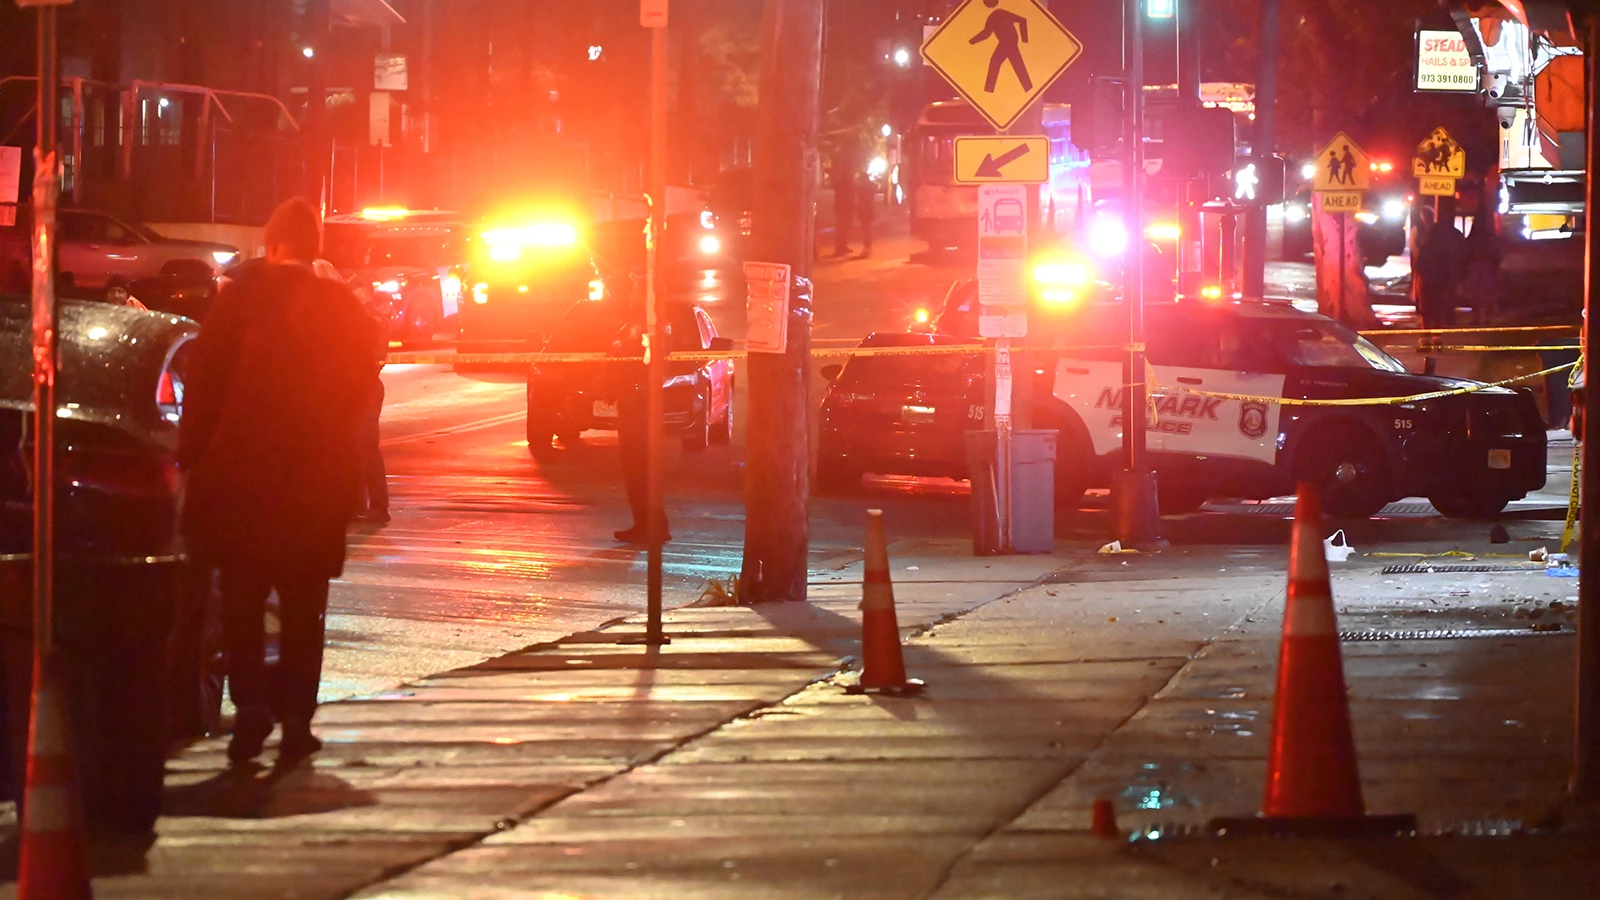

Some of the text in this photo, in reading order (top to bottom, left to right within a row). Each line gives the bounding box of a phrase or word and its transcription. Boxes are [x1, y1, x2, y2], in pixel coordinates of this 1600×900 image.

[1424, 38, 1466, 52] STEAD
[1421, 57, 1471, 67] NAILS & SP
[1423, 181, 1452, 191] AHEAD
[1324, 196, 1359, 207] AHEAD
[967, 404, 985, 421] 515
[1393, 418, 1413, 430] 515
